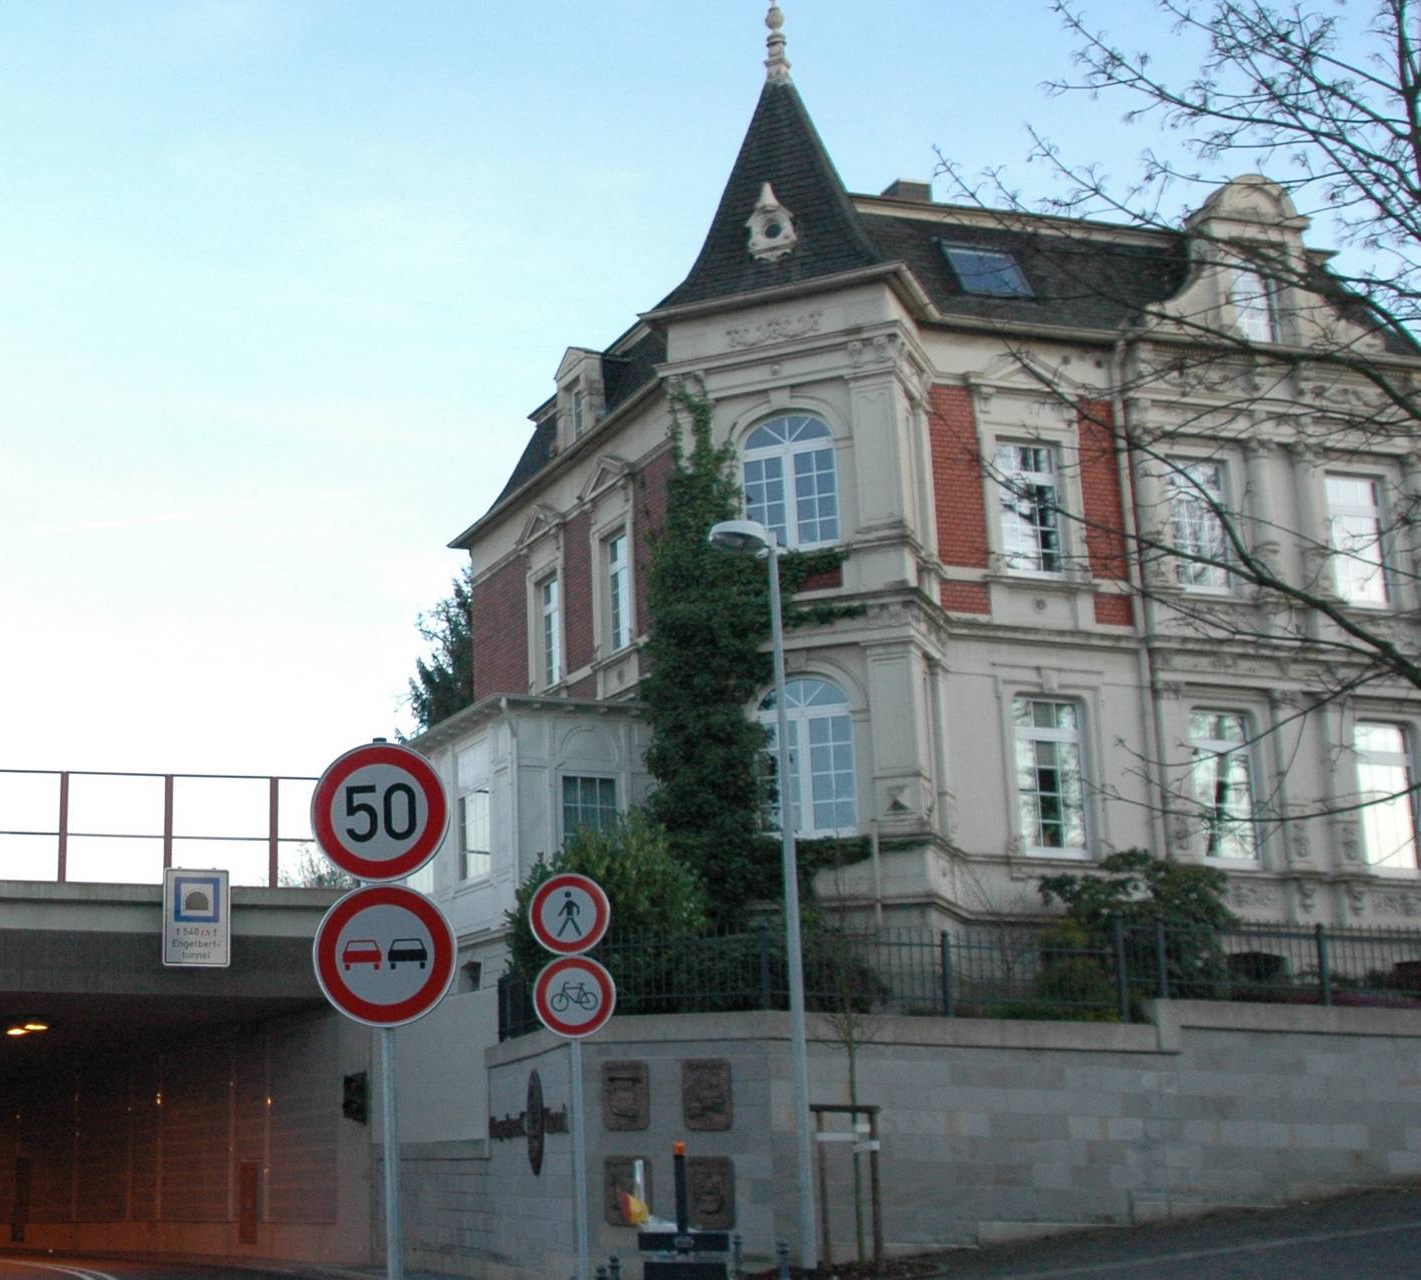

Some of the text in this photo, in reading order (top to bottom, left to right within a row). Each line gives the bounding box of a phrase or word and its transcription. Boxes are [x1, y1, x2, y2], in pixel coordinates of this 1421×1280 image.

[346, 783, 417, 842] 50
[183, 927, 200, 936] 540
[172, 939, 221, 949] Engelbert-
[181, 951, 211, 960] tunnel
